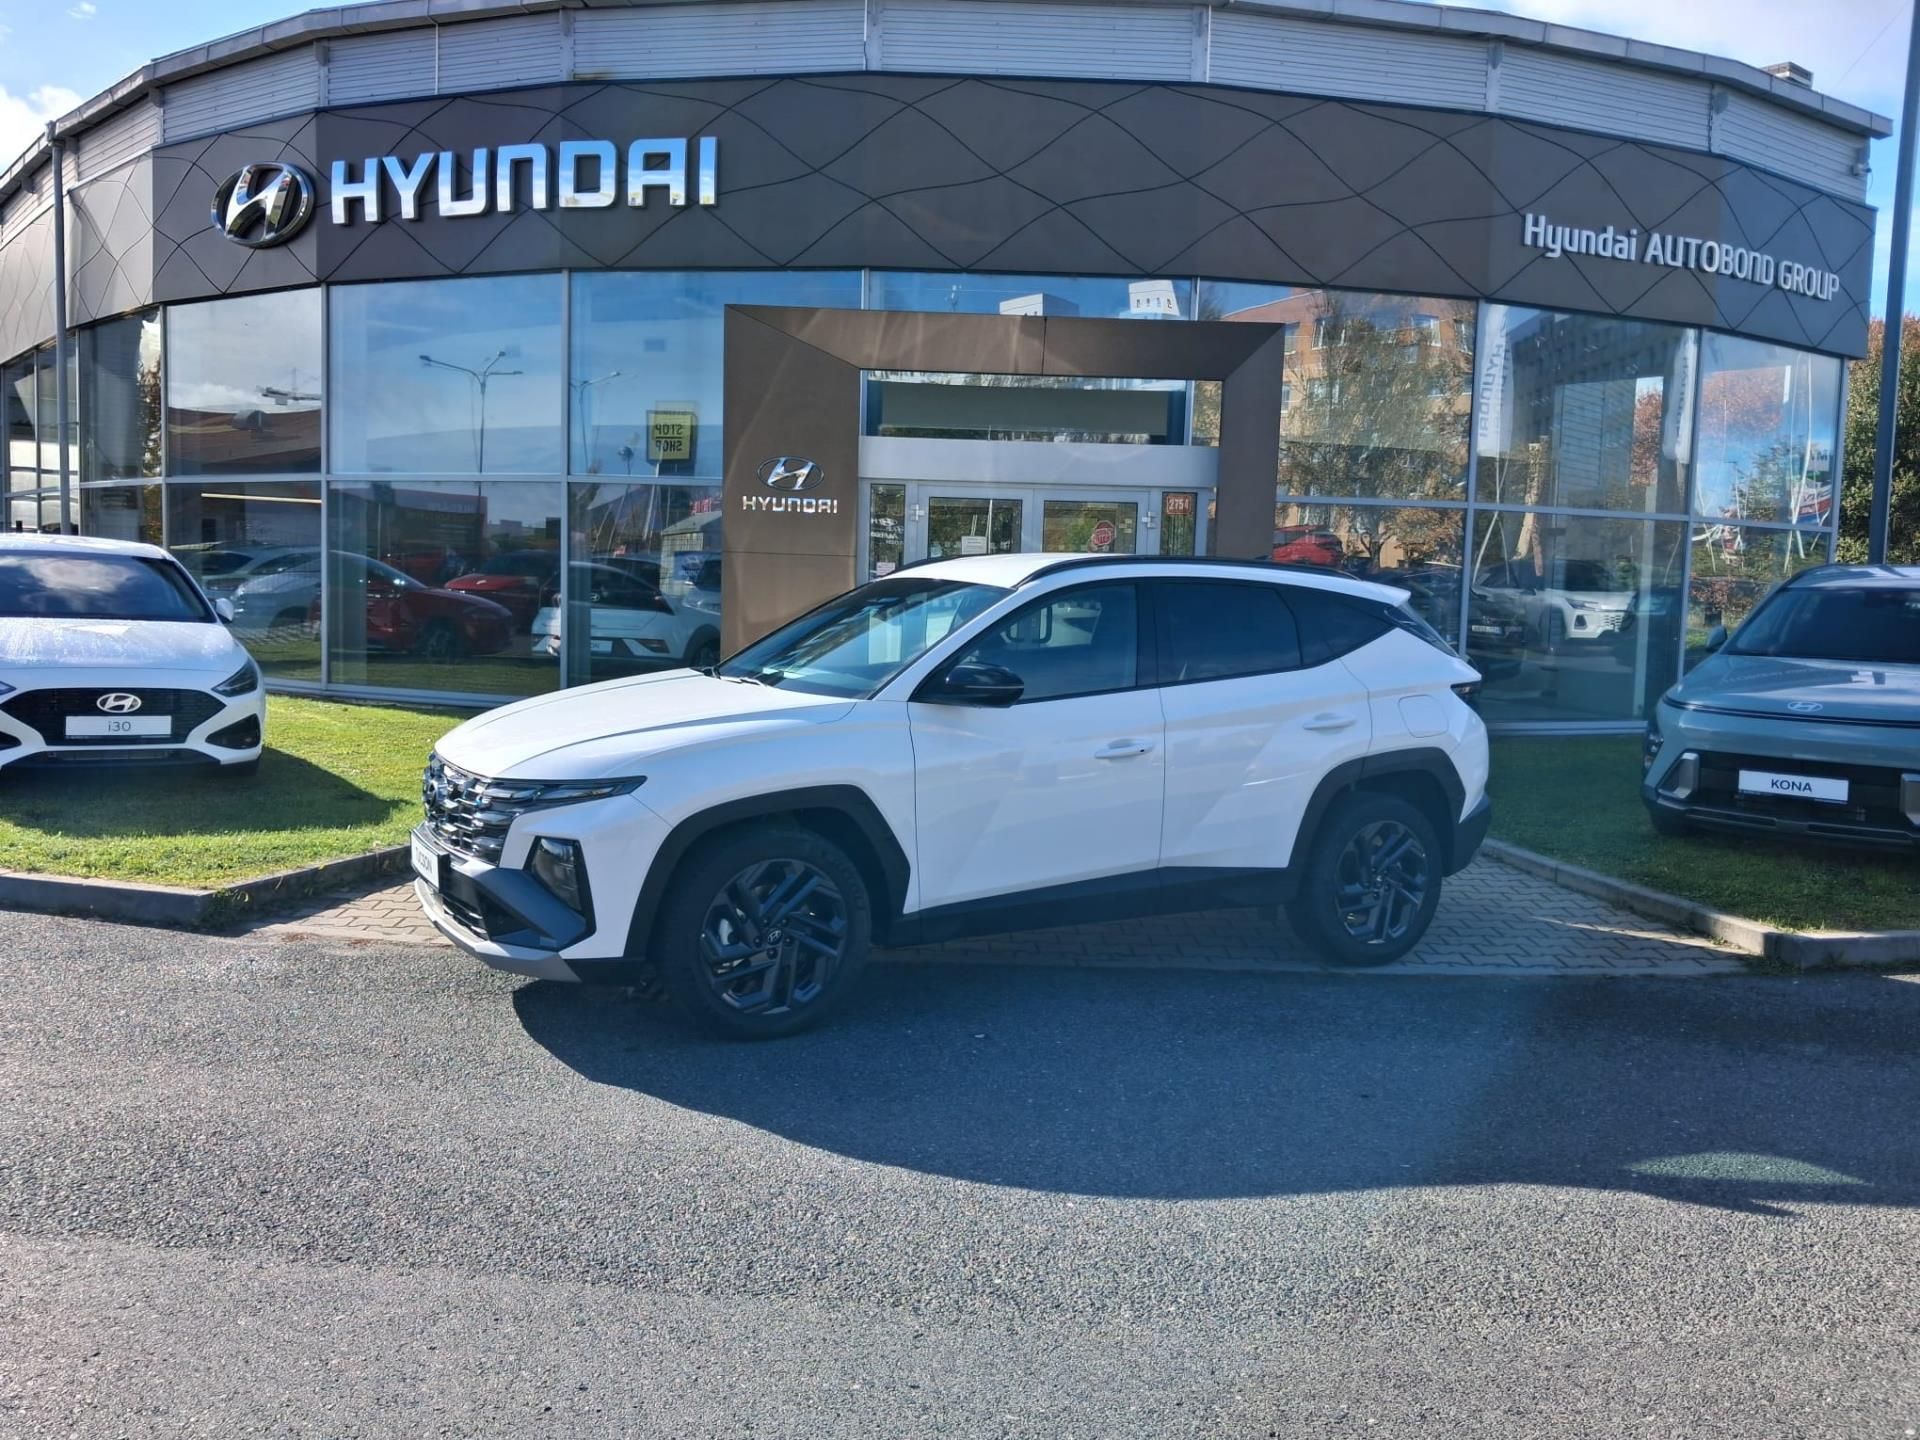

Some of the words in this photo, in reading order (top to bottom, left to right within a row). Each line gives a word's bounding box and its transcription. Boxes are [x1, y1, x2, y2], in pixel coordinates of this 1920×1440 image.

[331, 136, 718, 225] HYUNDAI
[1524, 213, 1637, 260] Hyundai
[1643, 233, 1774, 285] AUTOBOND
[1779, 261, 1840, 301] GROUP
[742, 495, 838, 514] HYUNDAI
[107, 721, 131, 732] i30
[1771, 778, 1812, 793] KONA
